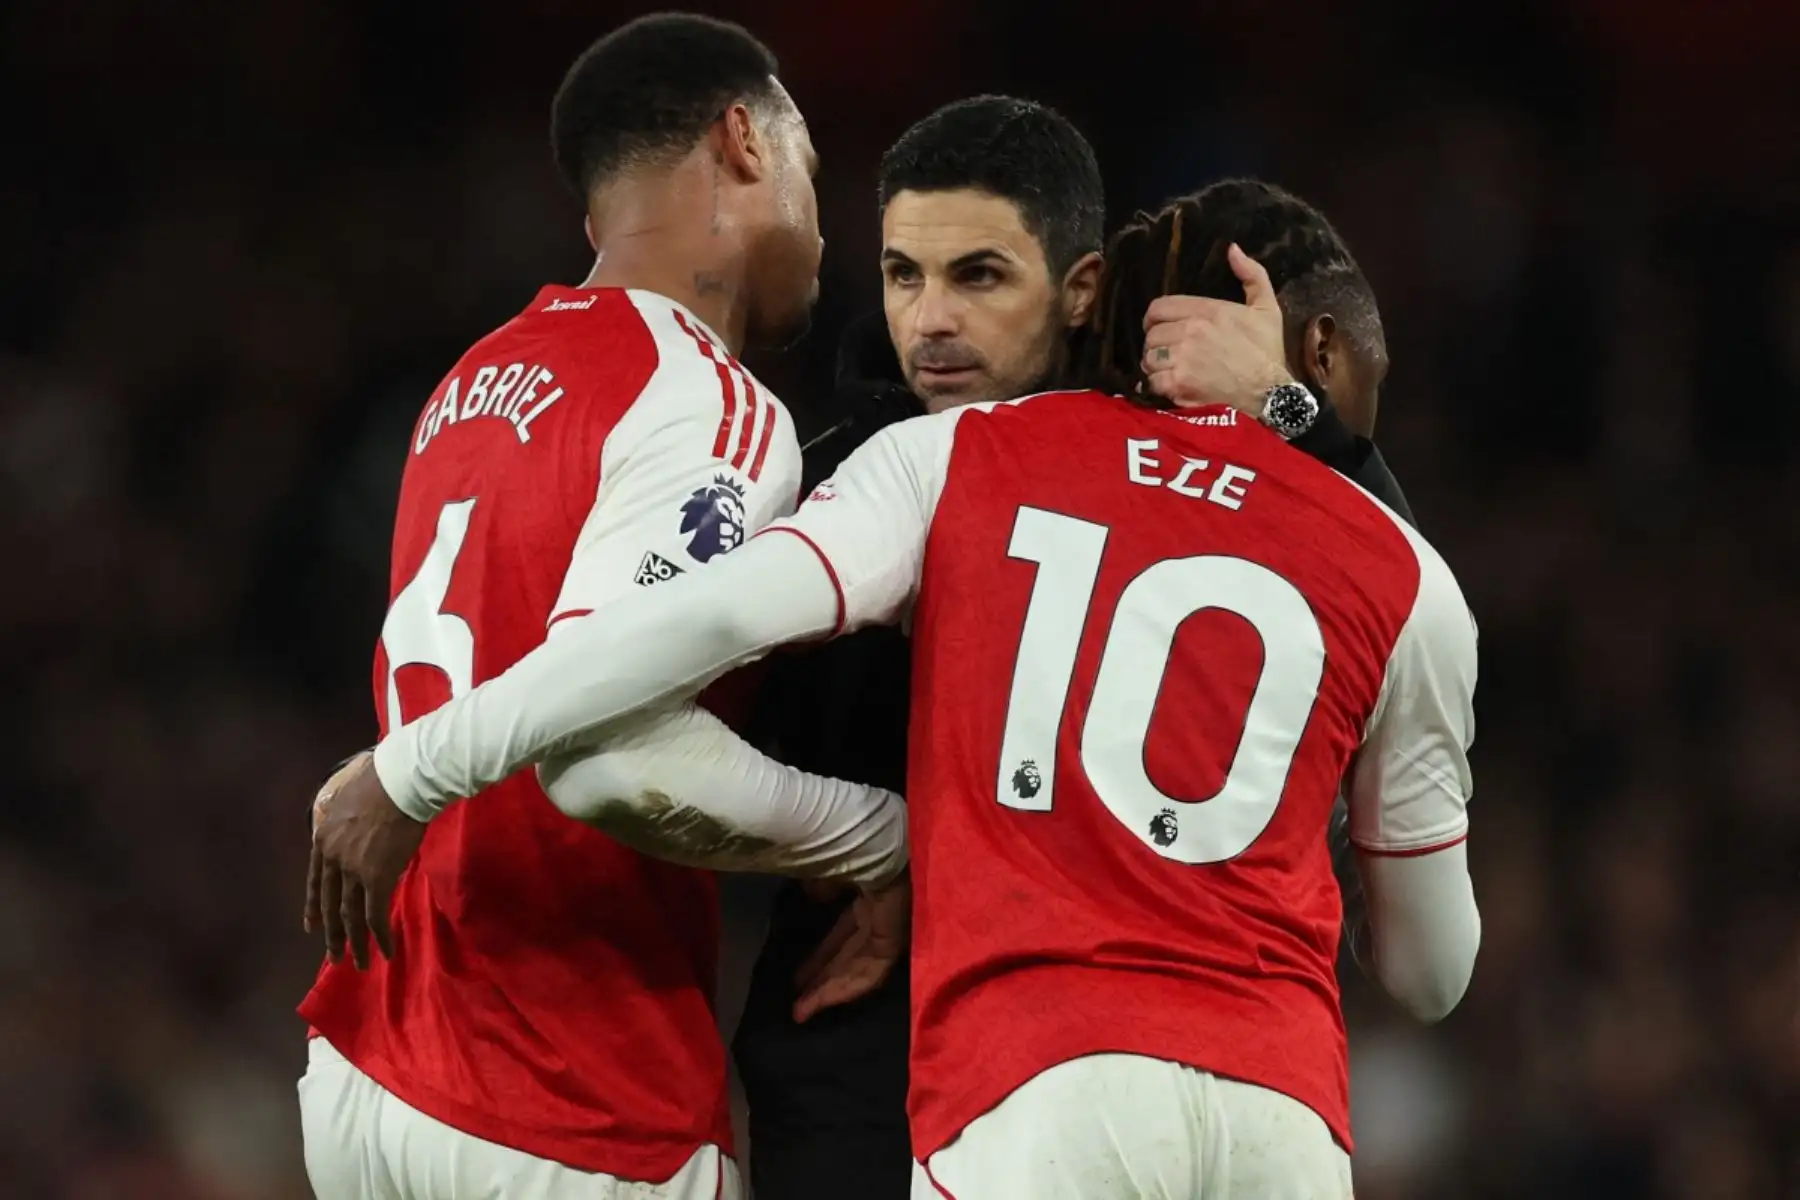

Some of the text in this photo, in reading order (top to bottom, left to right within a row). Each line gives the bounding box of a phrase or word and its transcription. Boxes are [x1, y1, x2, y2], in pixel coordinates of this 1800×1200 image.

[415, 363, 564, 455] GABRIEL
[1127, 437, 1256, 511] EZE
[382, 497, 475, 733] 6
[996, 505, 1328, 865] 10
